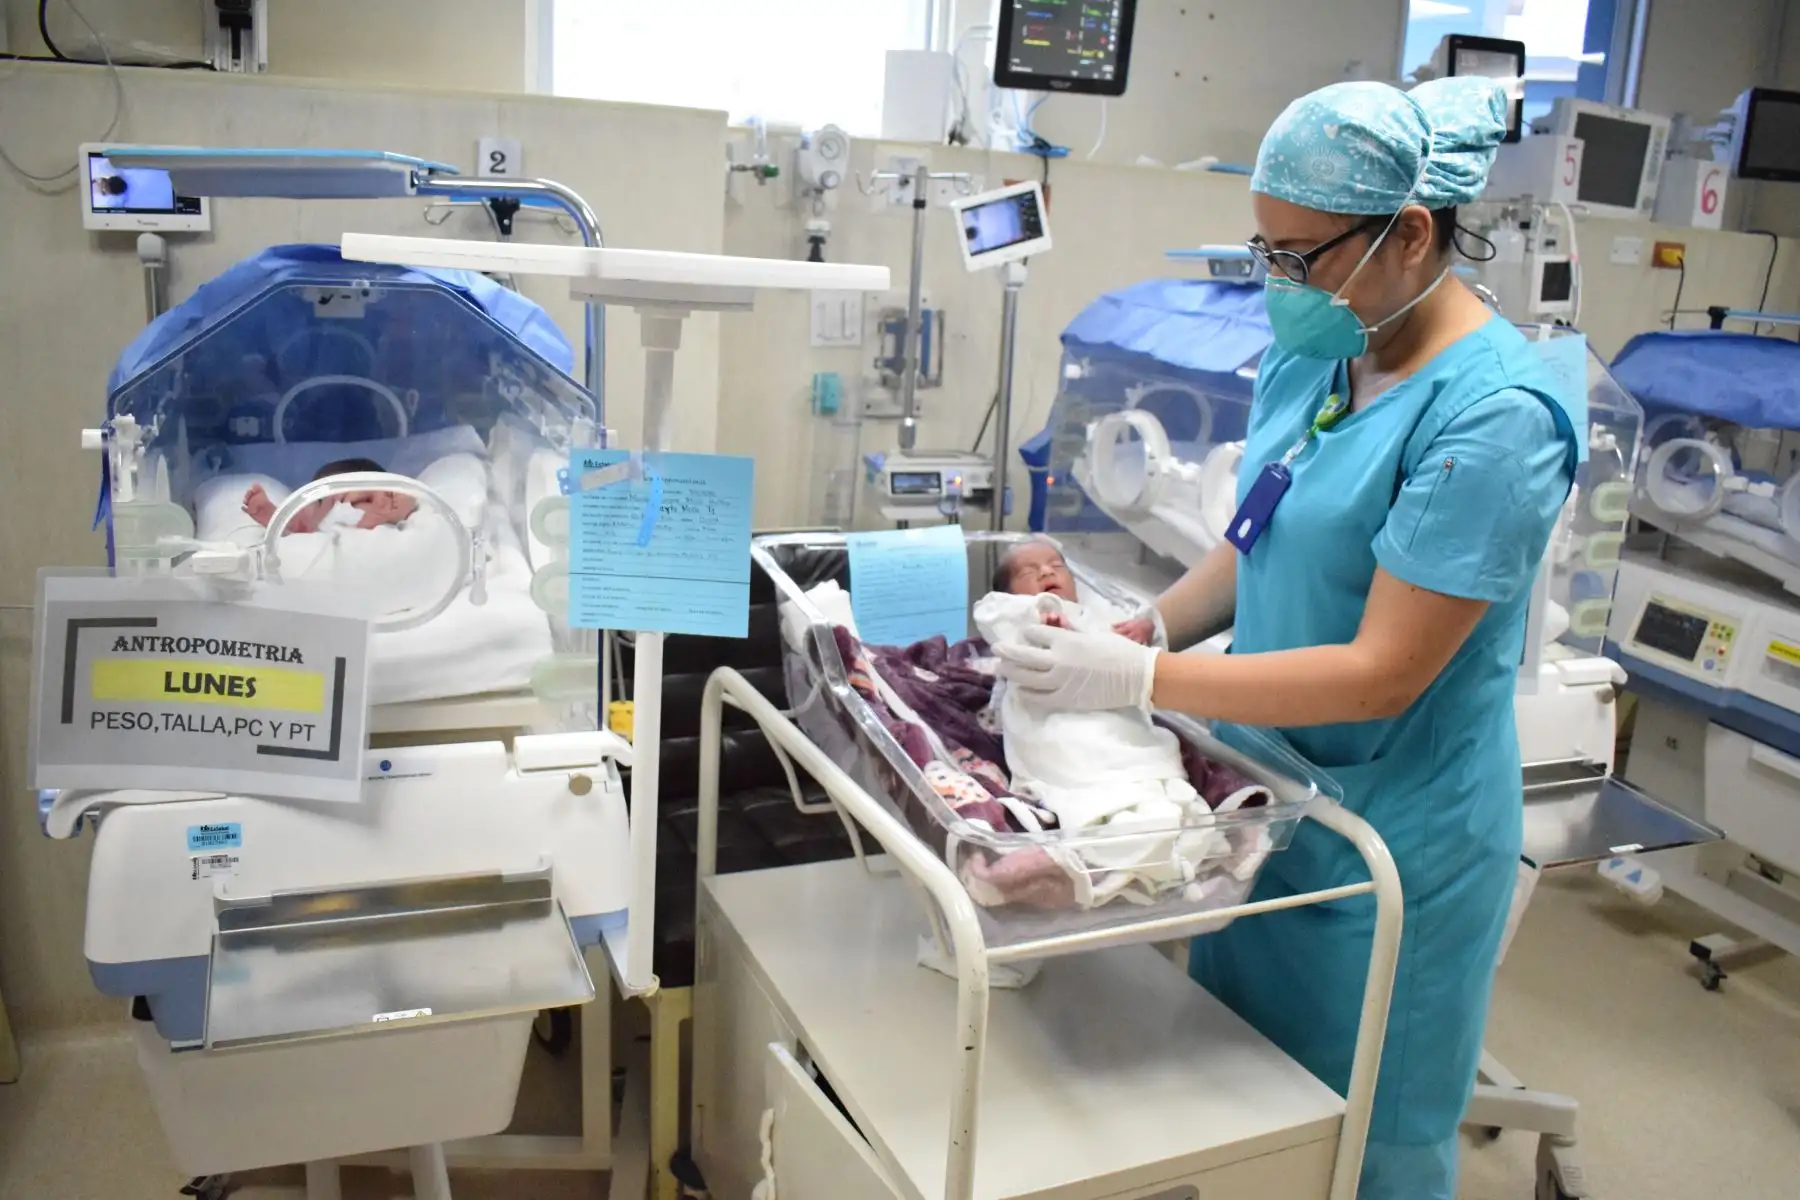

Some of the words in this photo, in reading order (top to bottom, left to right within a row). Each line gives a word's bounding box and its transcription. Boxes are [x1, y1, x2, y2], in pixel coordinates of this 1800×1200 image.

[489, 150, 507, 174] 2
[1563, 144, 1578, 186] 5
[1702, 170, 1719, 214] 6
[111, 635, 304, 664] ANTROPOMETRIA
[164, 671, 257, 698] LUNES
[269, 720, 283, 739] Y
[289, 722, 316, 742] PT
